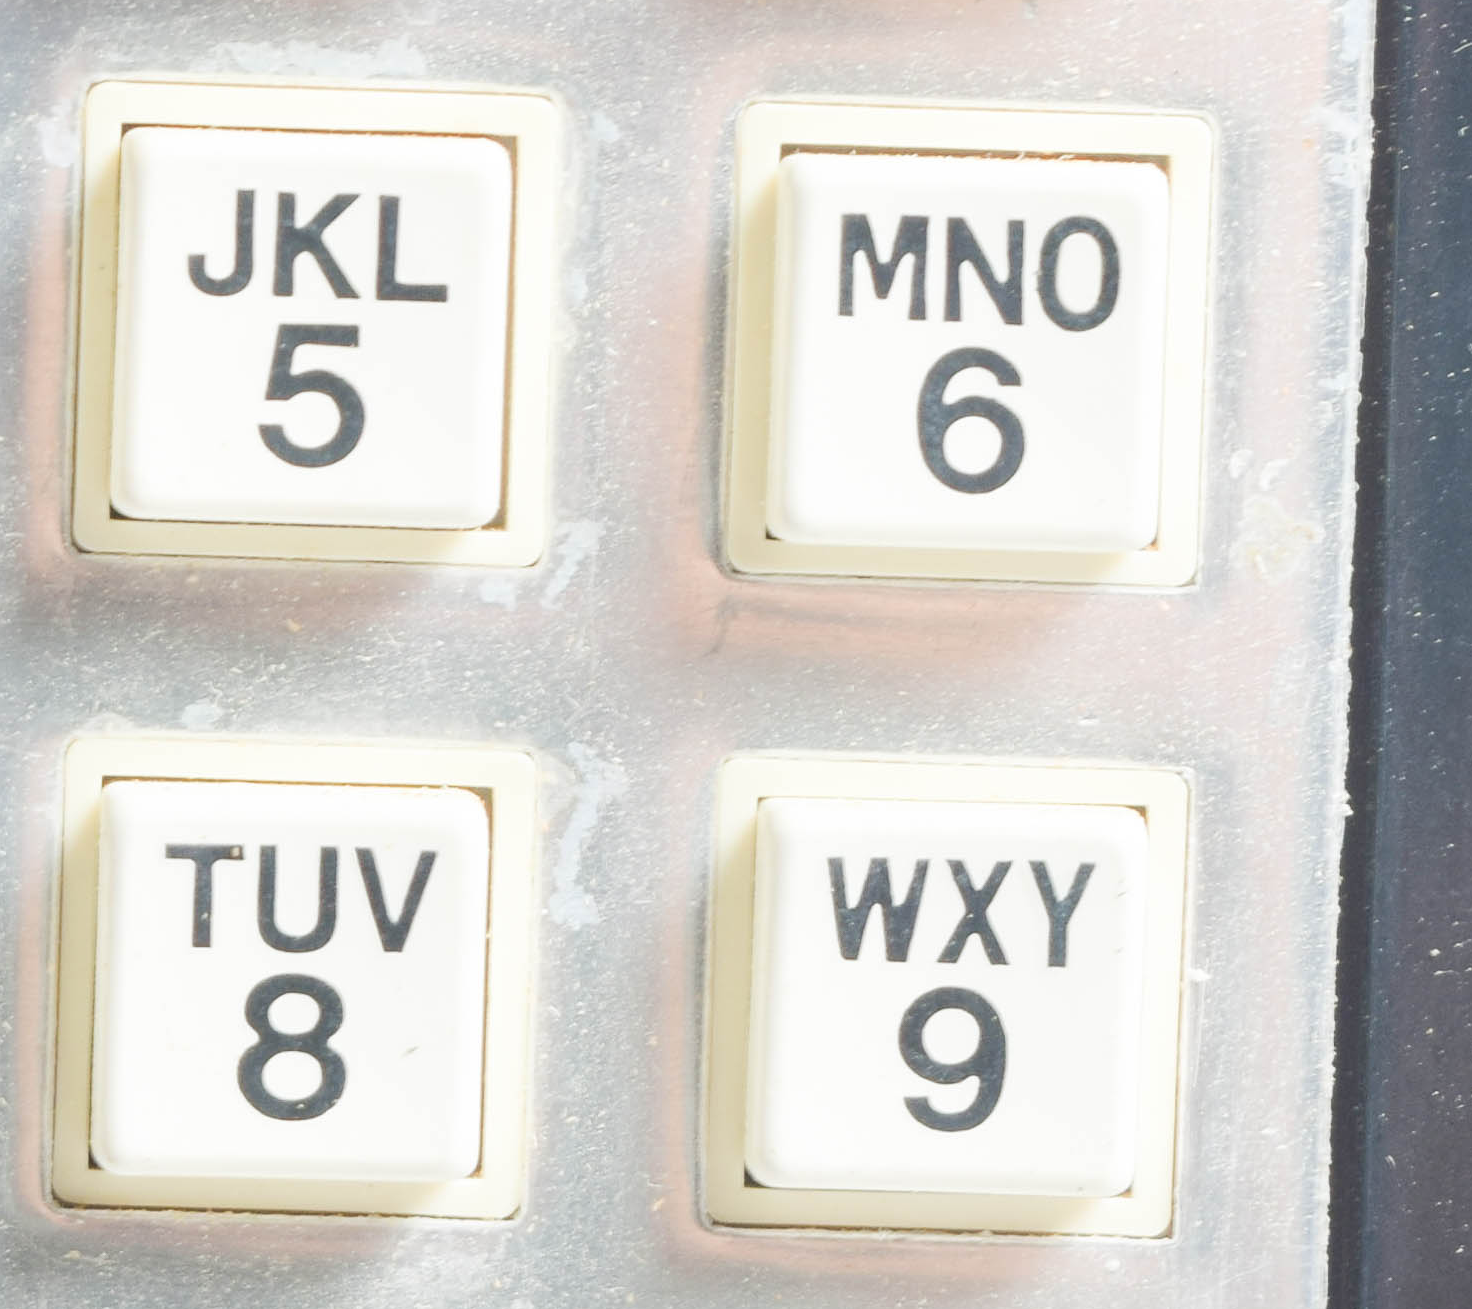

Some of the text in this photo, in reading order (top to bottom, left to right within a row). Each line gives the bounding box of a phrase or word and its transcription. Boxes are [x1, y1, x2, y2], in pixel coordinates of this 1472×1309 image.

[188, 189, 448, 304] JKL
[838, 214, 1121, 333] MNO
[259, 323, 366, 469] 5
[917, 347, 1026, 495] 6
[166, 844, 437, 954] TUV
[830, 859, 1094, 968] WXY
[237, 973, 347, 1122] 8
[898, 986, 1008, 1134] 9
